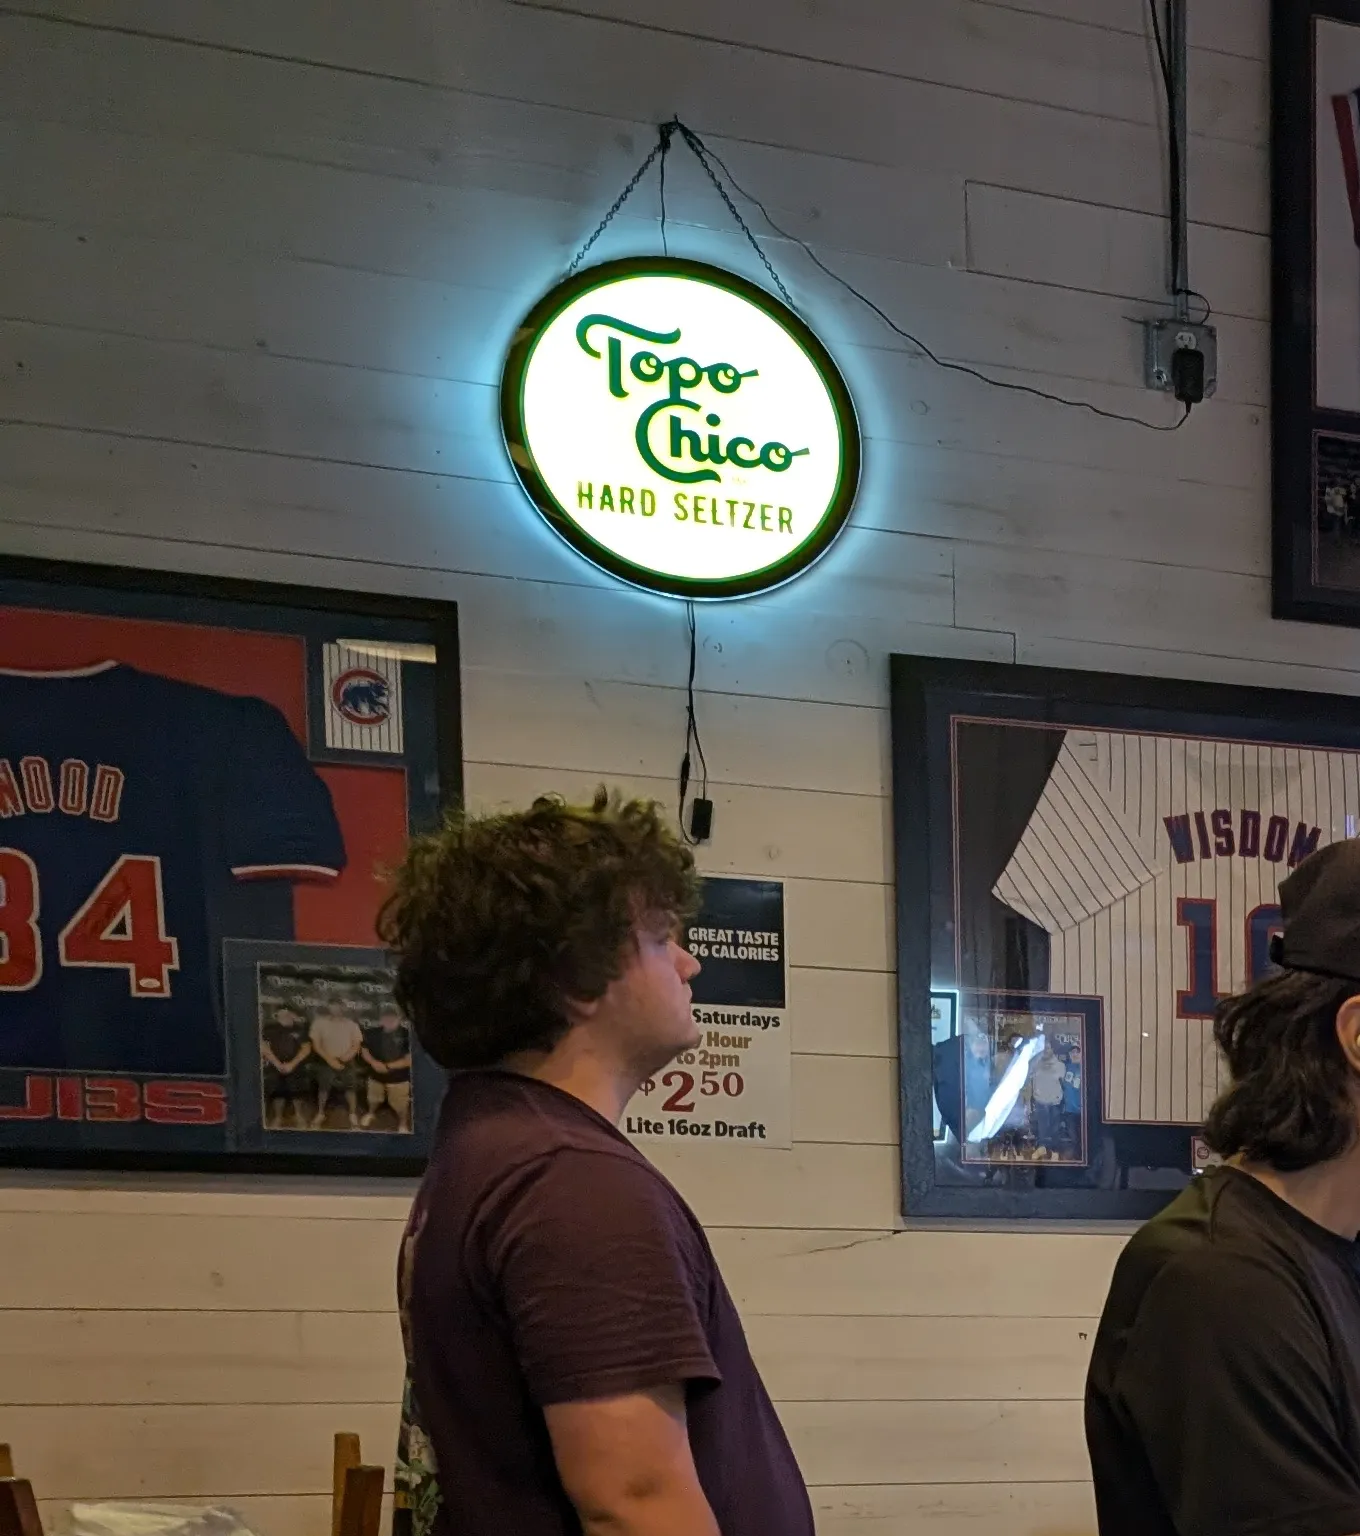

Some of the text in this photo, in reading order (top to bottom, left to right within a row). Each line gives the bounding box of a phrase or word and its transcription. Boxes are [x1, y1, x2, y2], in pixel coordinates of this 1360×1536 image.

[576, 314, 759, 399] Topo
[635, 399, 810, 483] Chico
[577, 481, 794, 534] HARD SELTZER
[1162, 809, 1322, 868] WISDOM
[688, 927, 779, 946] GREAT TASTE
[688, 942, 779, 961] 96 CALORIES
[692, 1009, 781, 1030] Saturdays
[706, 1031, 752, 1049] Hour
[676, 1050, 740, 1069] to 2pm
[626, 1117, 766, 1139] Lite 16oz Draft
